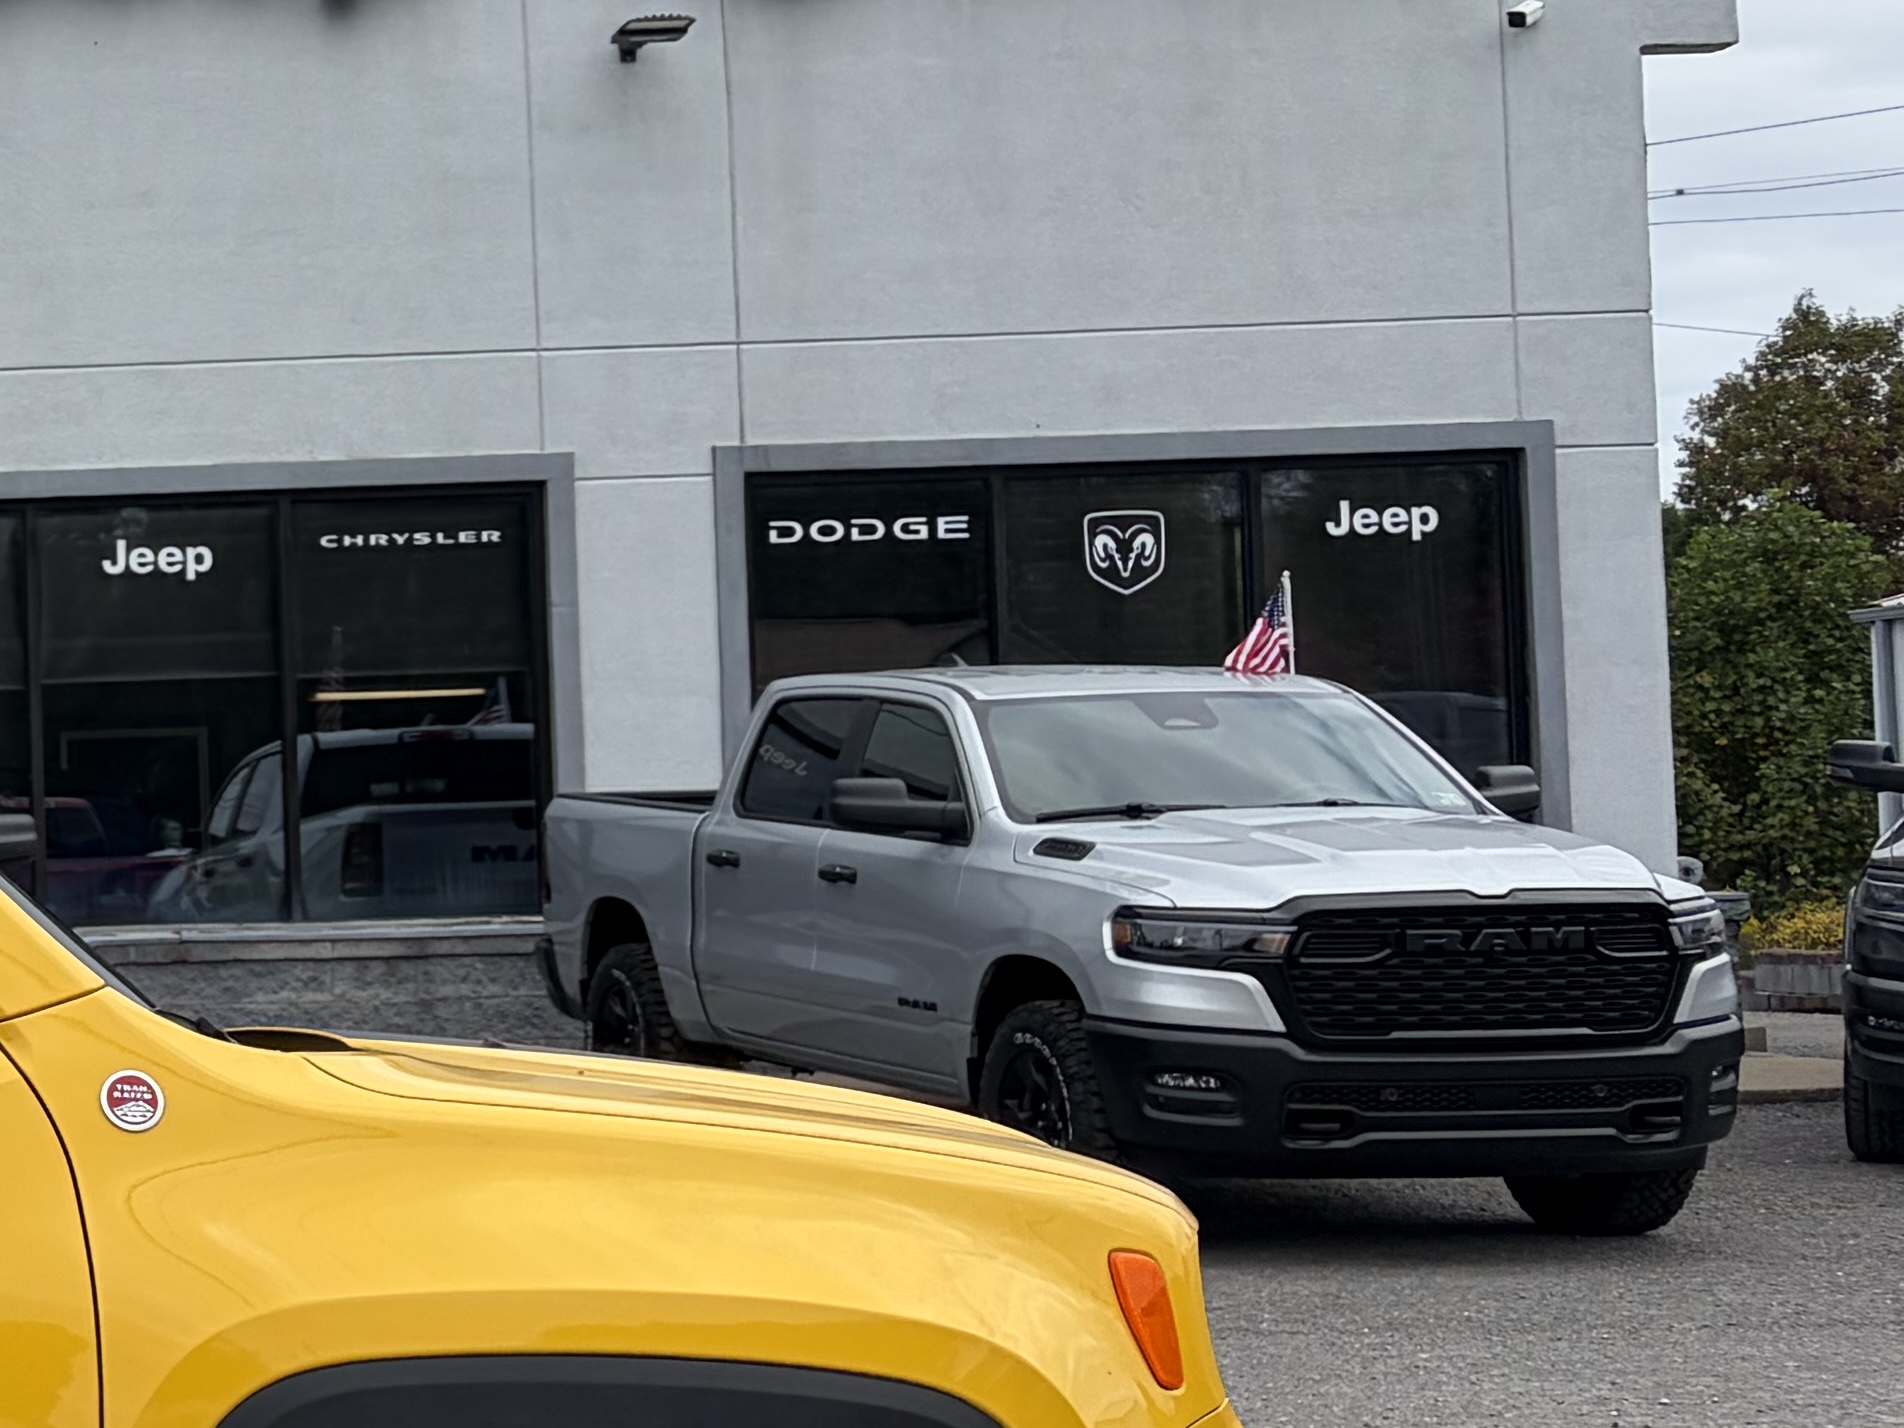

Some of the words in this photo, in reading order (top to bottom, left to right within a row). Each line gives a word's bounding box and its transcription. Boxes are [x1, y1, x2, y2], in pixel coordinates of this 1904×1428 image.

[768, 514, 971, 545] DODGE
[1325, 499, 1439, 542] Jeep
[319, 529, 503, 548] CHRYSLER
[102, 539, 214, 581] Jeep
[1405, 926, 1586, 951] RAM
